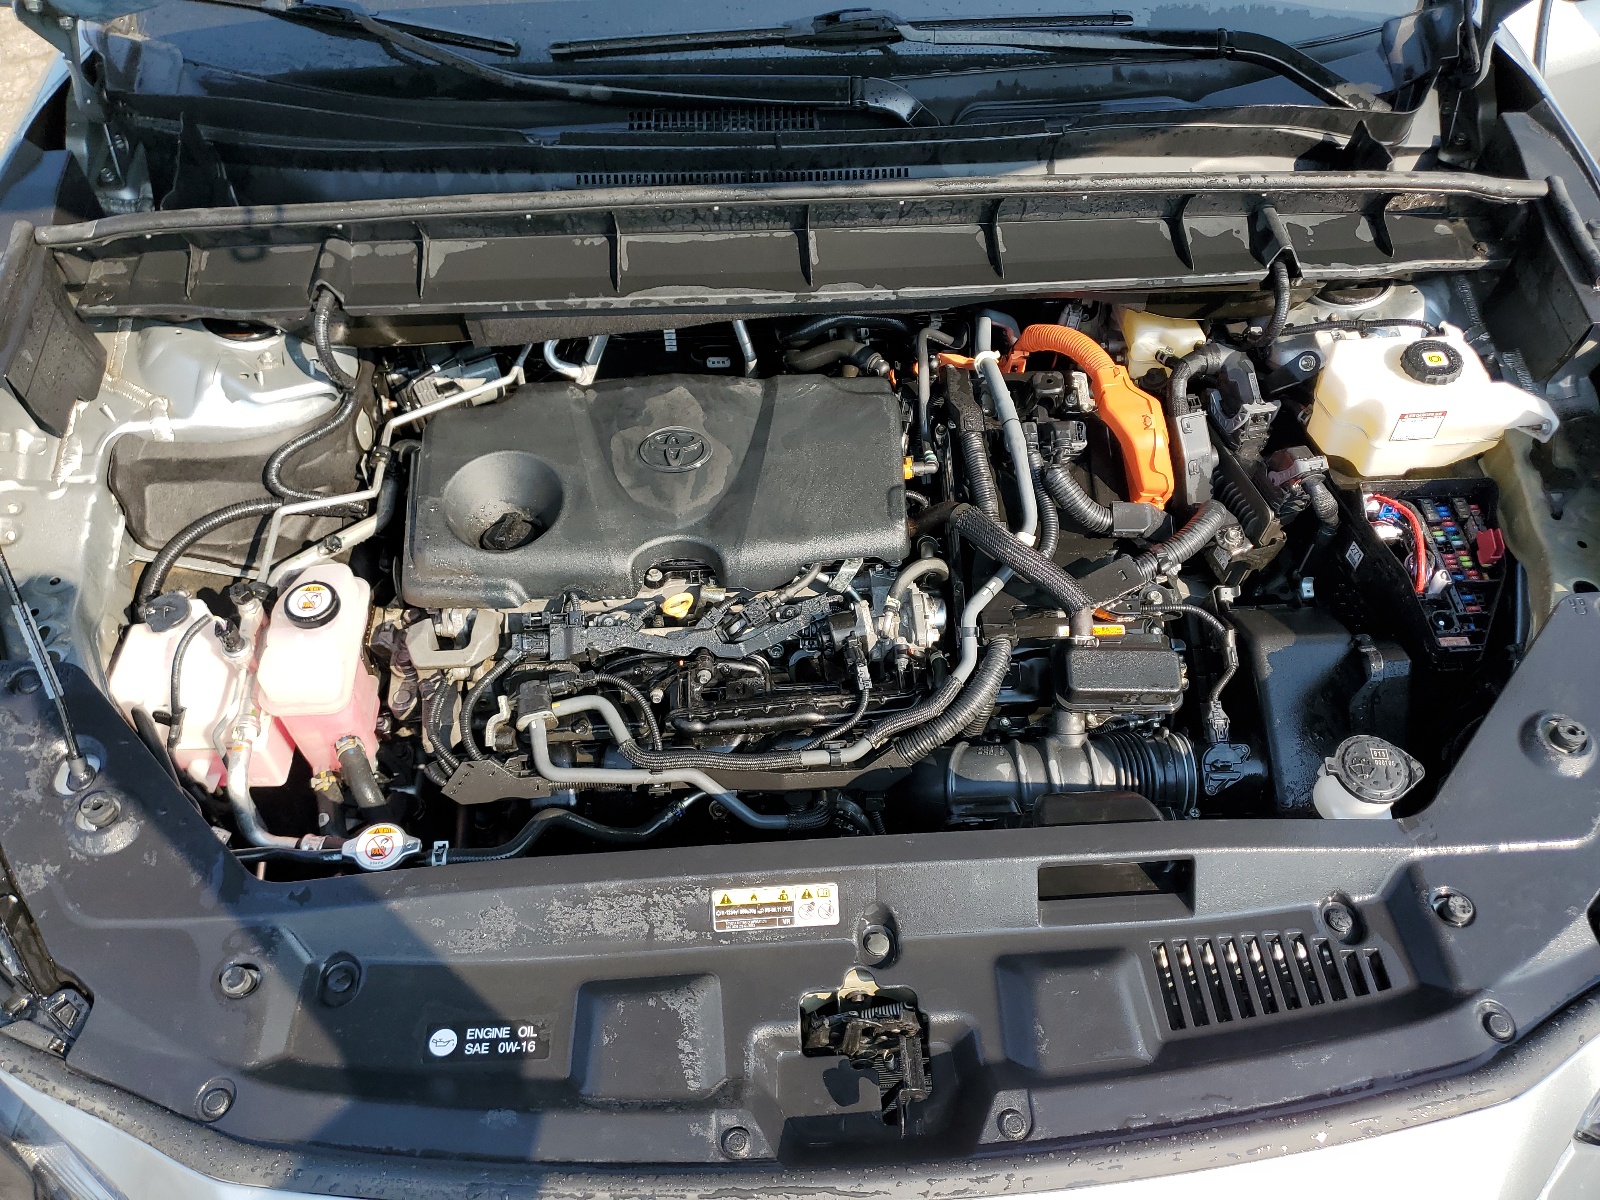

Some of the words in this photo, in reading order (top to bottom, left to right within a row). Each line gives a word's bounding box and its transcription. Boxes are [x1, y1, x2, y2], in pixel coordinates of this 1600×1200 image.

[466, 1027, 510, 1039] ENGINE
[517, 1026, 537, 1037] OIL
[464, 1043, 490, 1054] SAE
[498, 1041, 536, 1053] 0W-16
